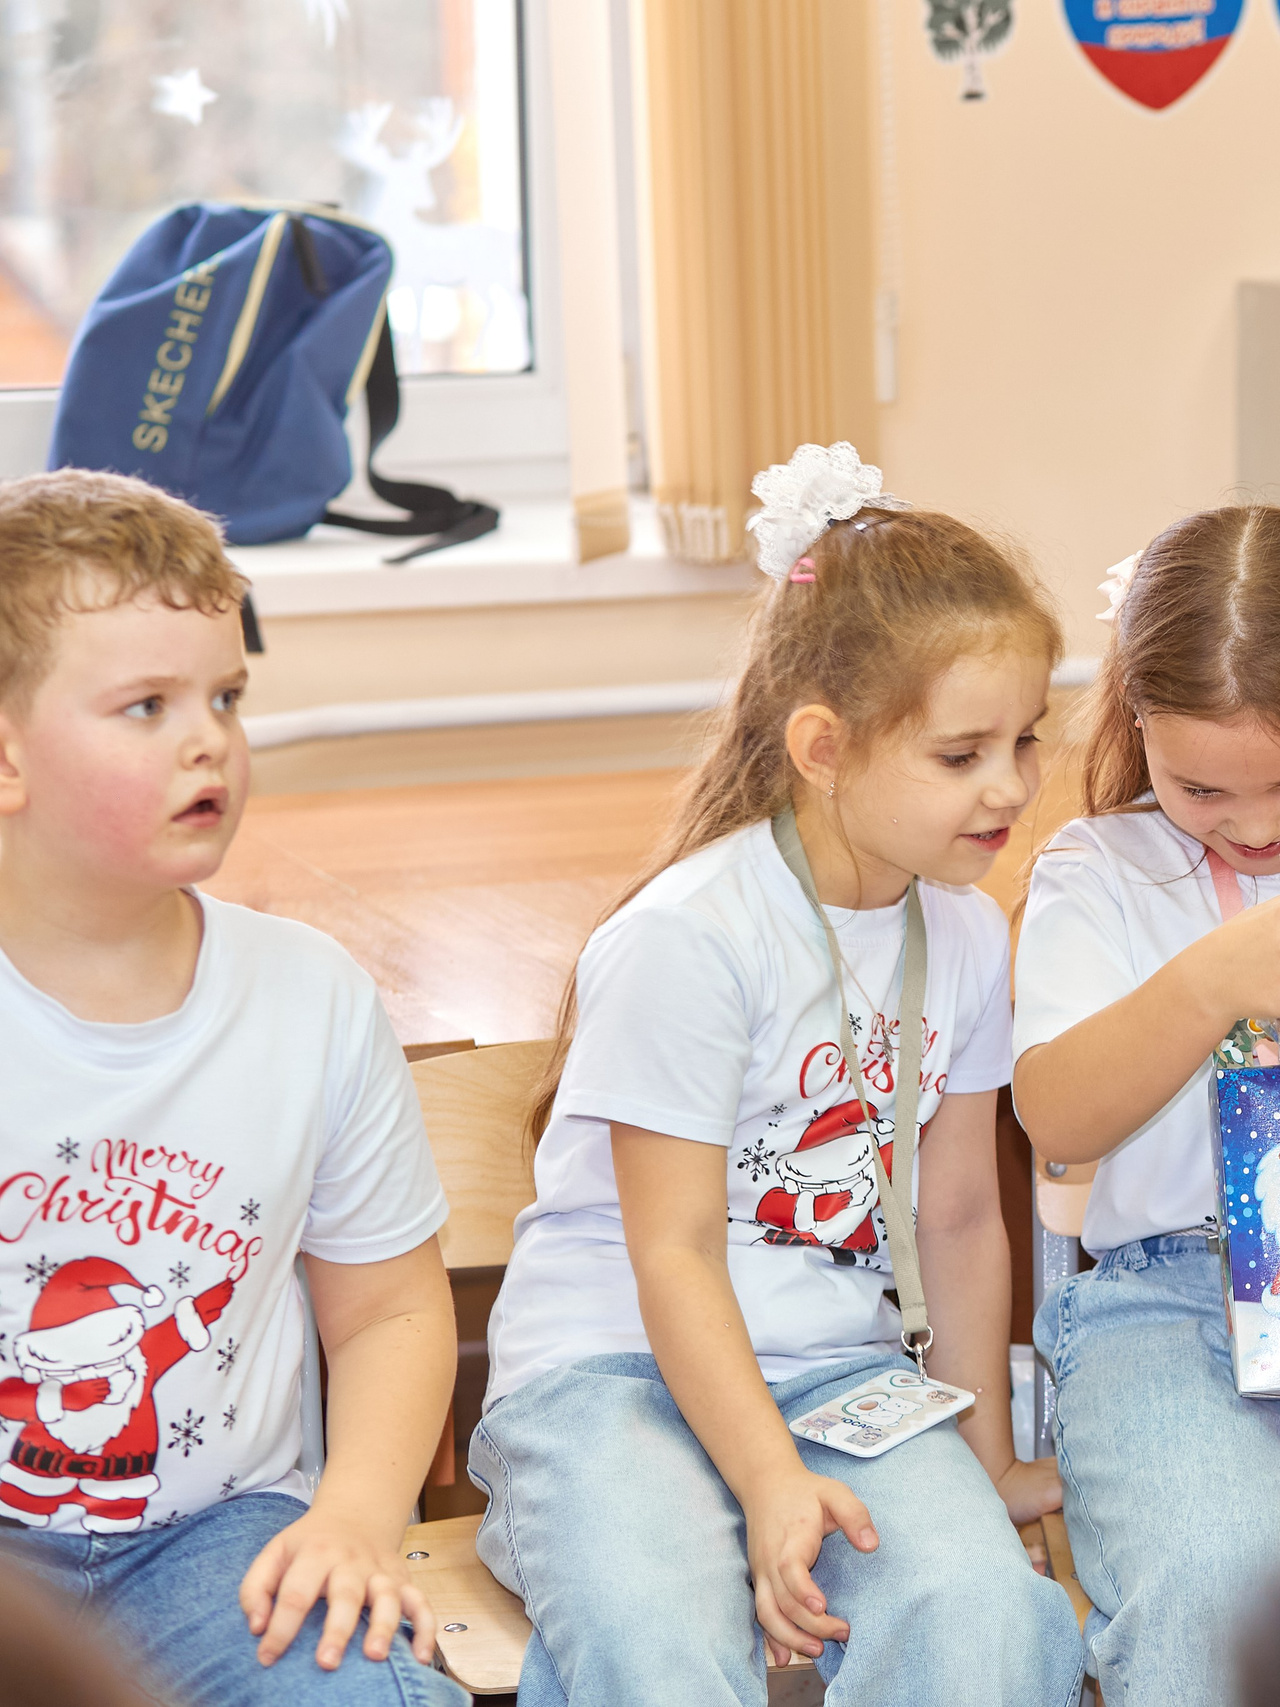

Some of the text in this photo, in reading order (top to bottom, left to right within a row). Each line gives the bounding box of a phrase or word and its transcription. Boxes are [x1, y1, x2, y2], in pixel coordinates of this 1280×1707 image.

[132, 252, 220, 453] SKECHER
[91, 1138, 225, 1199] Merry
[0, 1171, 263, 1283] Christmas
